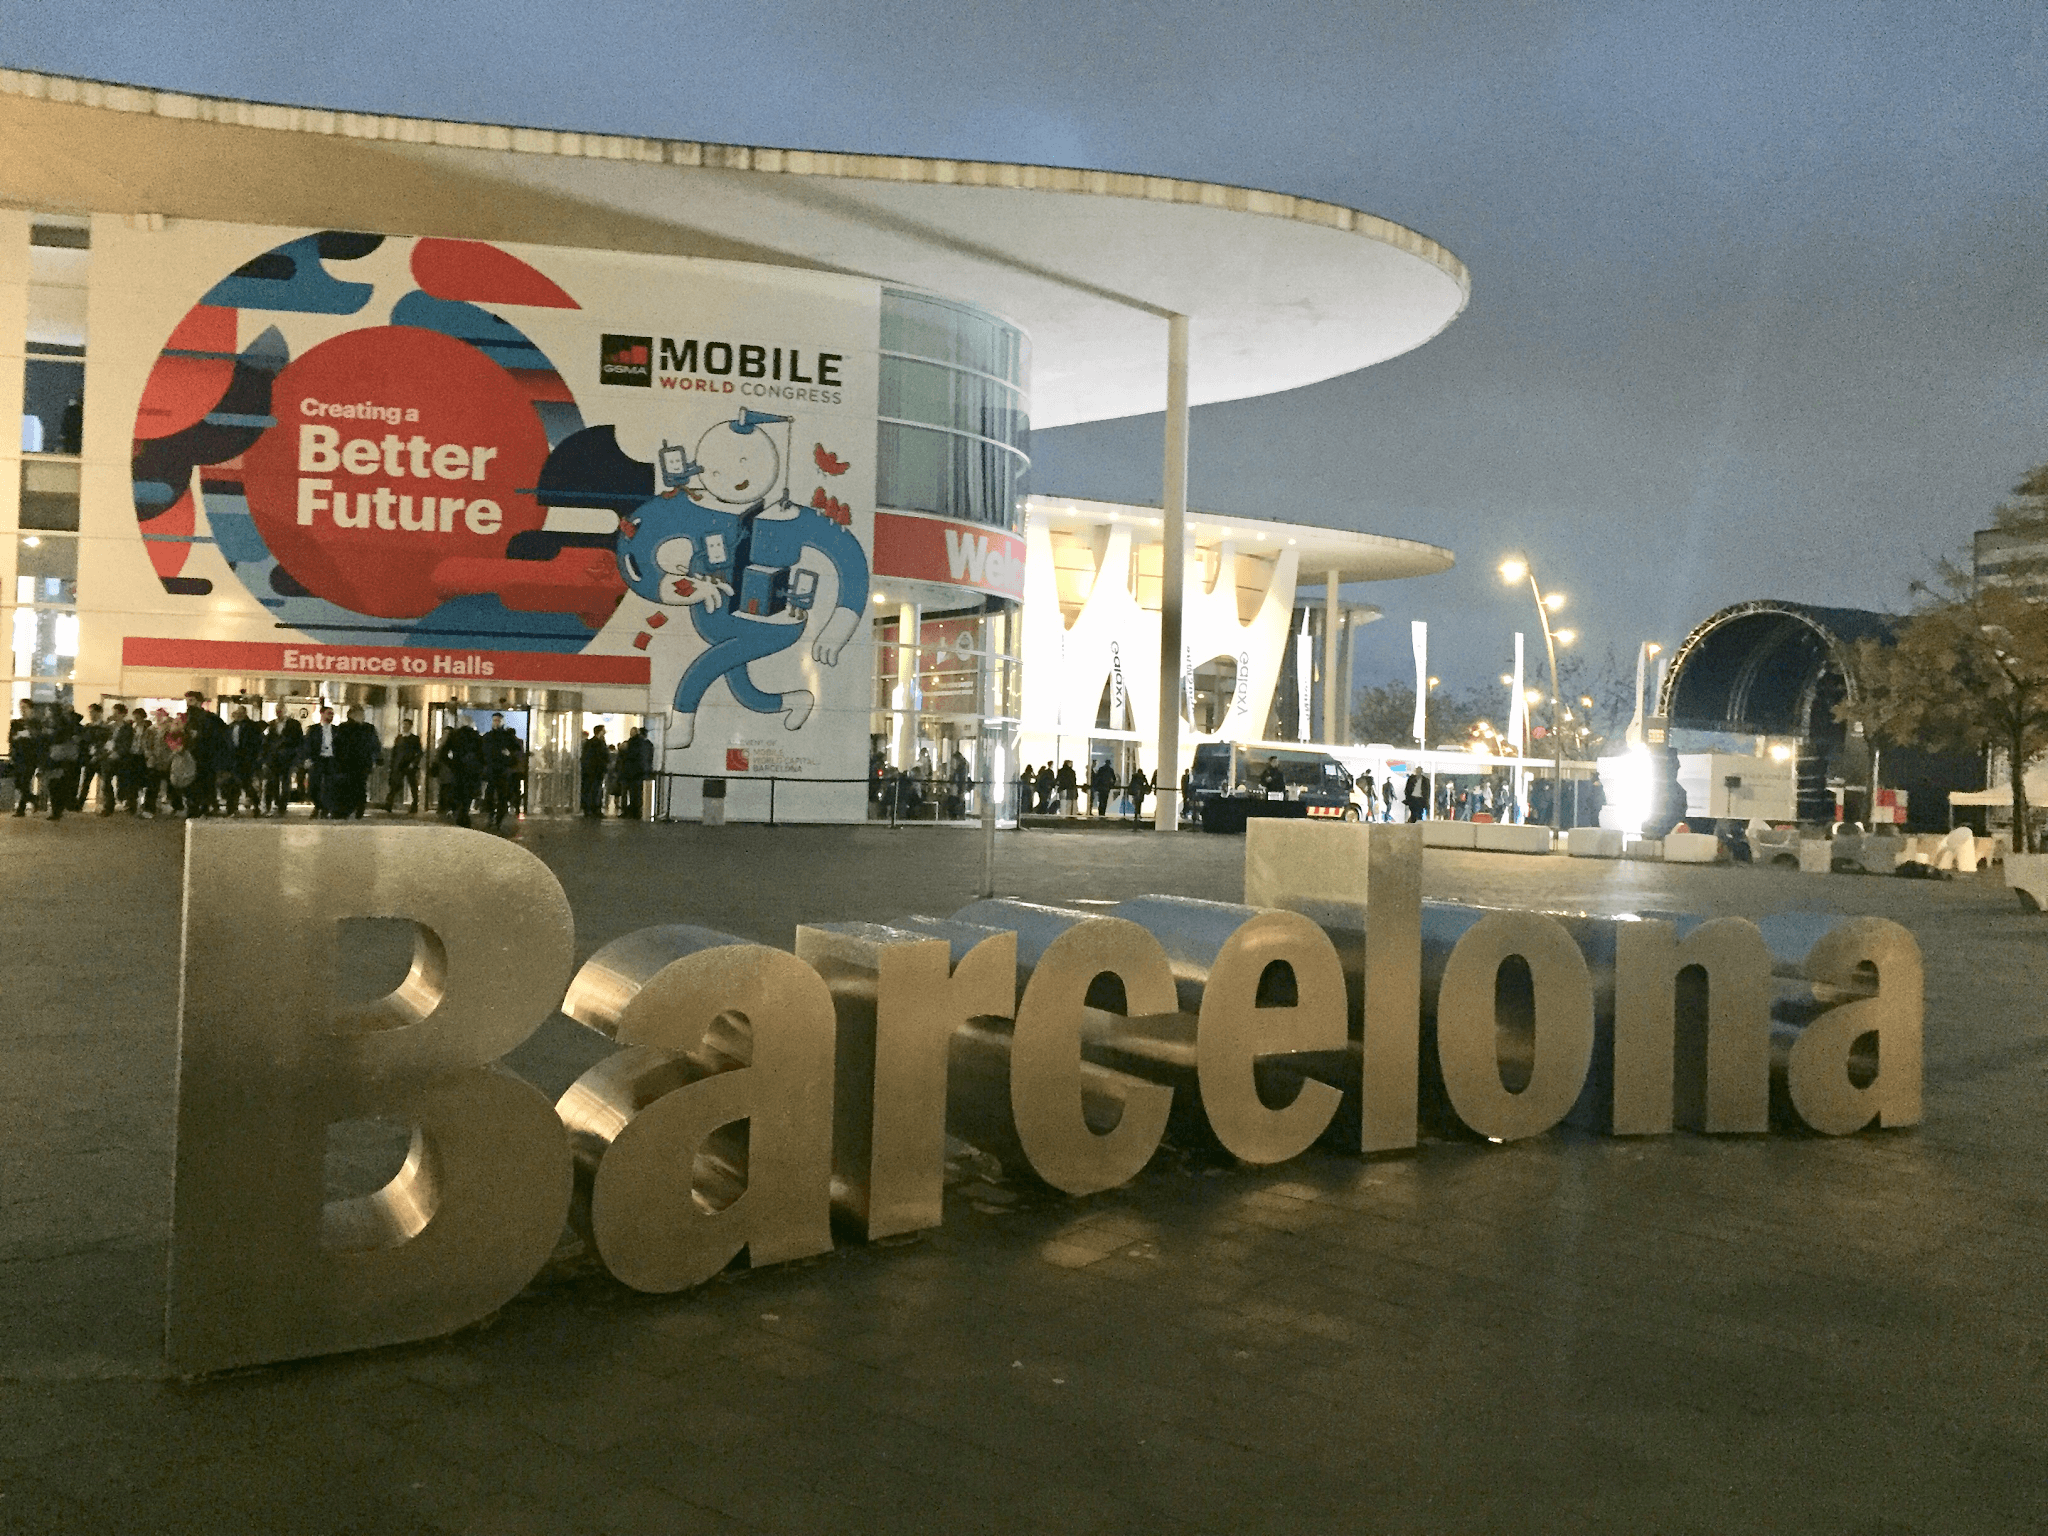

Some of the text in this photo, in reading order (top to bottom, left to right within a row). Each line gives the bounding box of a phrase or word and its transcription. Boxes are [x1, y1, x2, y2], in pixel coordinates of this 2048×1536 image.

[603, 364, 648, 376] GSMA
[659, 337, 843, 387] MOBILE
[659, 376, 843, 405] WORLD CONGRESS
[300, 397, 420, 426] Creating a
[298, 423, 499, 481] Better
[296, 477, 504, 535] Future
[282, 649, 495, 676] Entrance to Halls
[752, 764, 803, 773] BARCELONA
[163, 818, 1927, 1382] Barcelona
